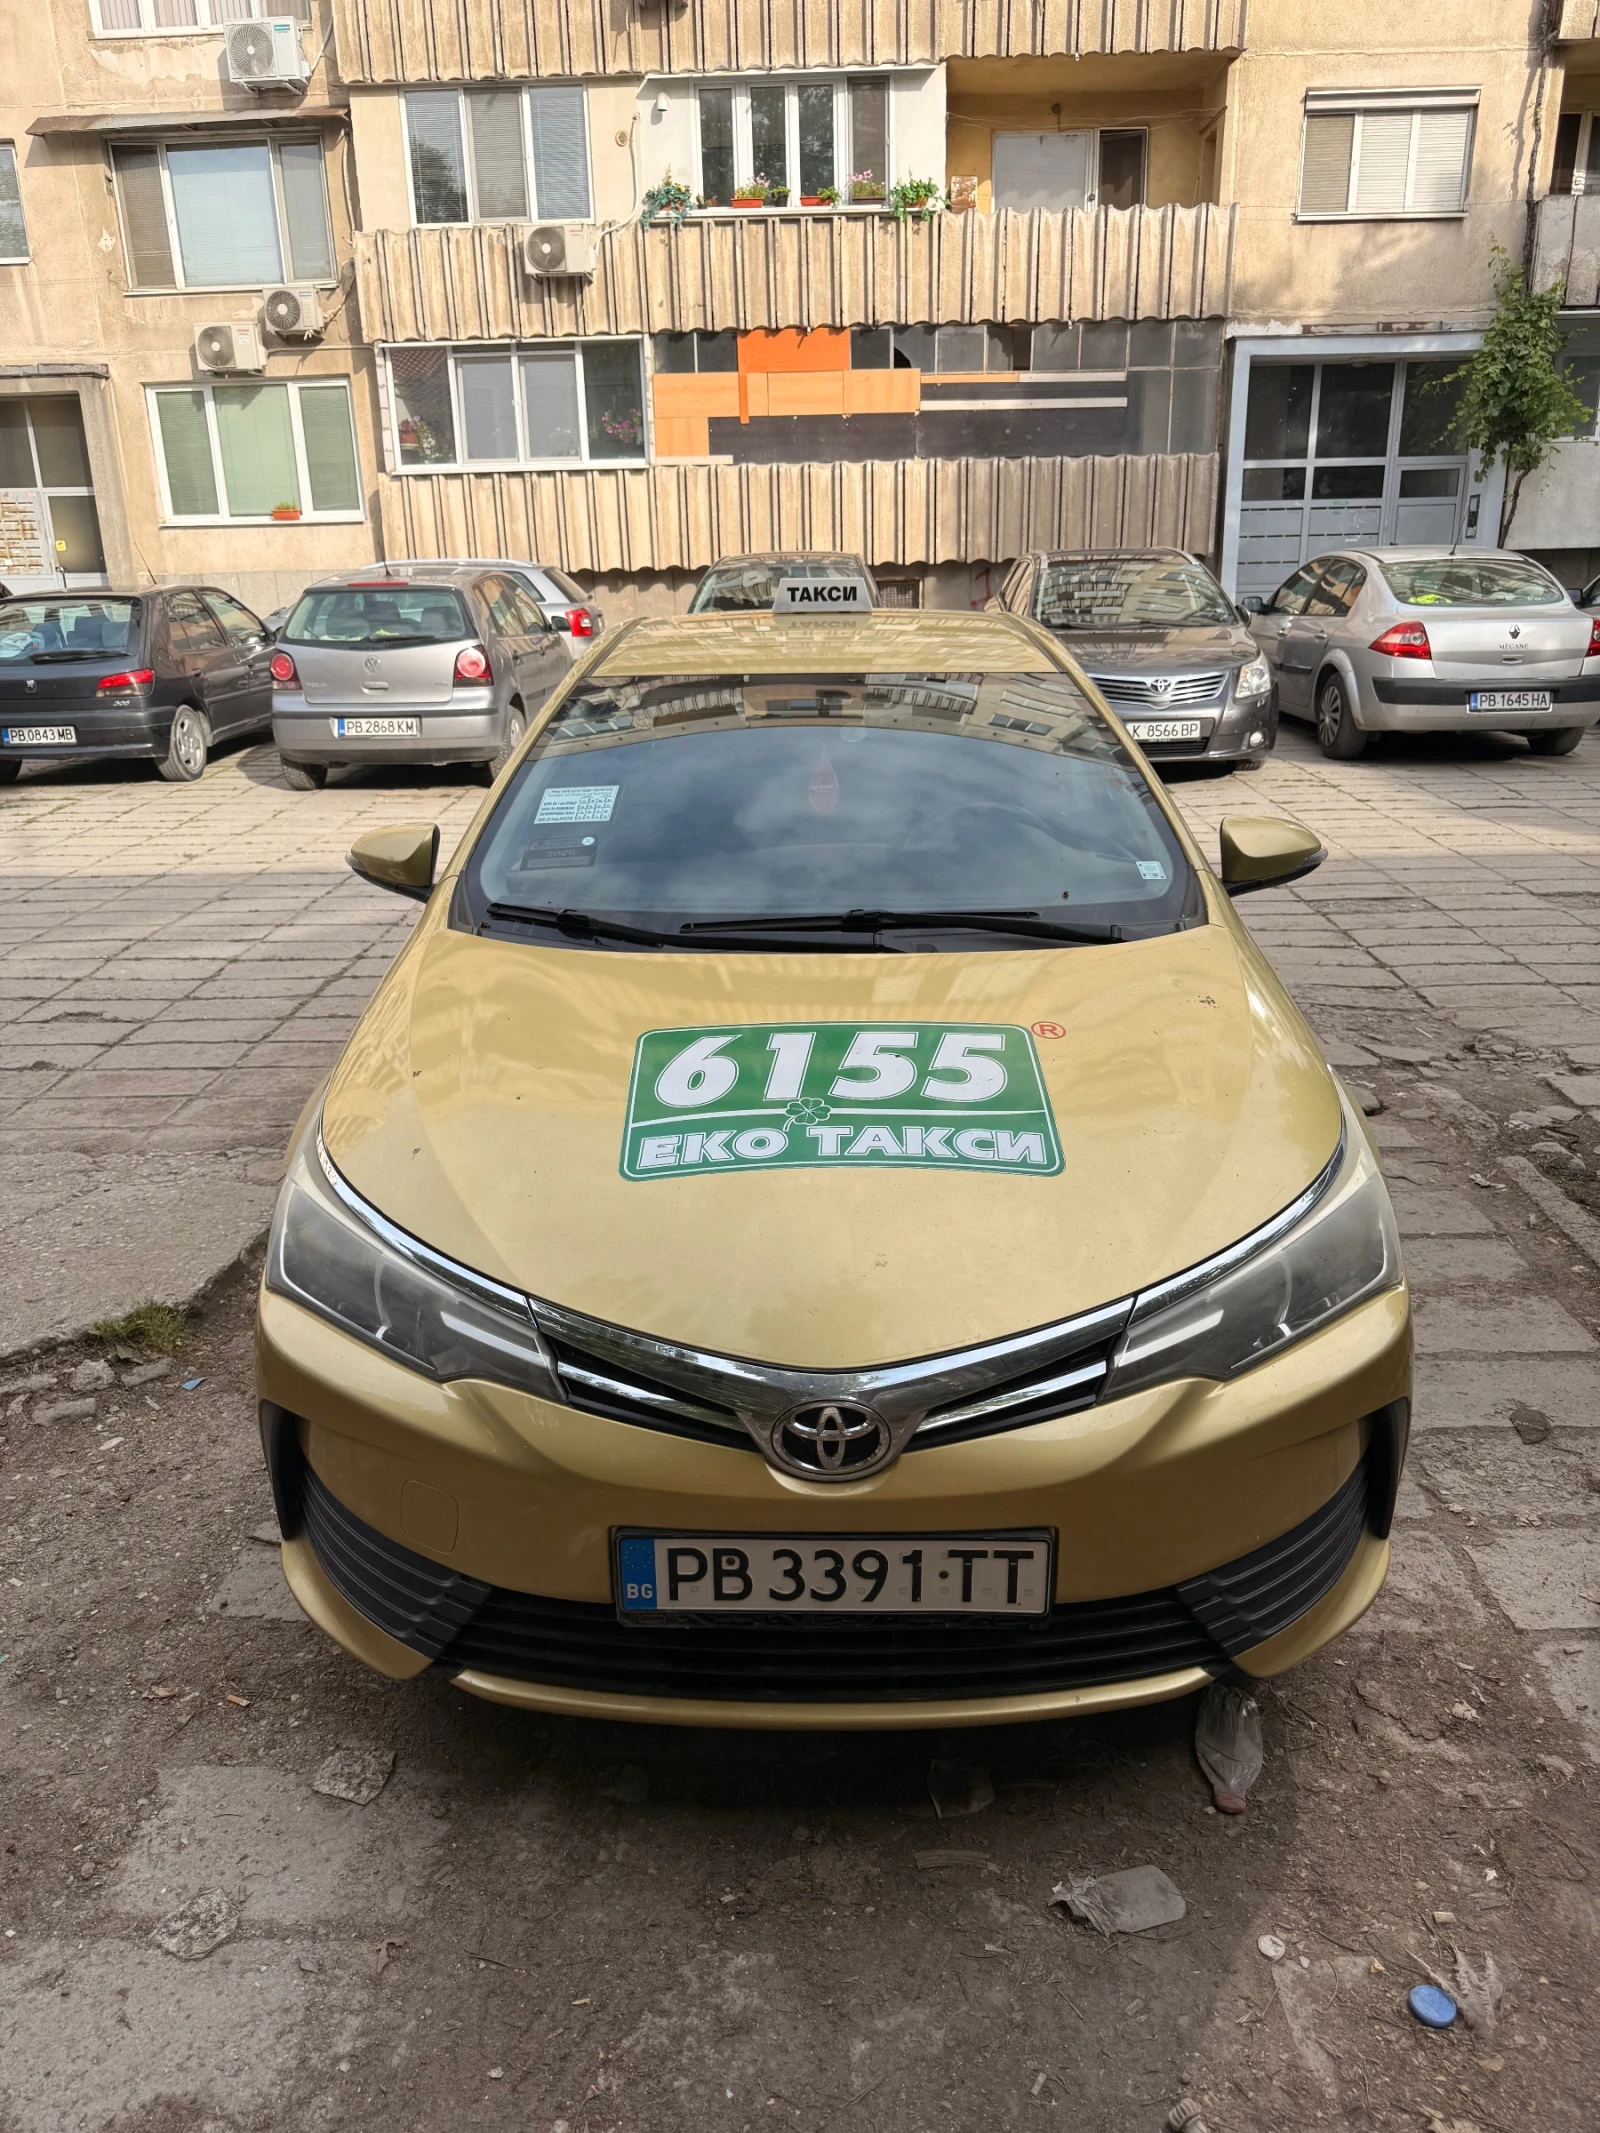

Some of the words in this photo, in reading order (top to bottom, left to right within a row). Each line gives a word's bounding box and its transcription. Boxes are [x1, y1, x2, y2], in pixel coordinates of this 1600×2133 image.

[786, 585, 858, 603] ТАКСИ
[1479, 694, 1496, 707] PB
[1501, 693, 1530, 707] 1645
[1531, 693, 1548, 706] HA
[9, 729, 26, 742] PB
[27, 728, 56, 741] 0843
[57, 728, 74, 741] MB
[346, 720, 363, 734] PB
[365, 720, 396, 734] 2868
[397, 720, 414, 734] KM
[1147, 724, 1179, 738] 8566
[1180, 723, 1199, 737] BP
[654, 1031, 1009, 1109] 6155
[636, 1128, 789, 1170] ЕКО
[807, 1125, 1049, 1165] ТАКСИ
[665, 1546, 755, 1603] PB
[768, 1547, 923, 1603] 3391
[946, 1548, 1036, 1605] TT
[626, 1582, 655, 1600] BG
